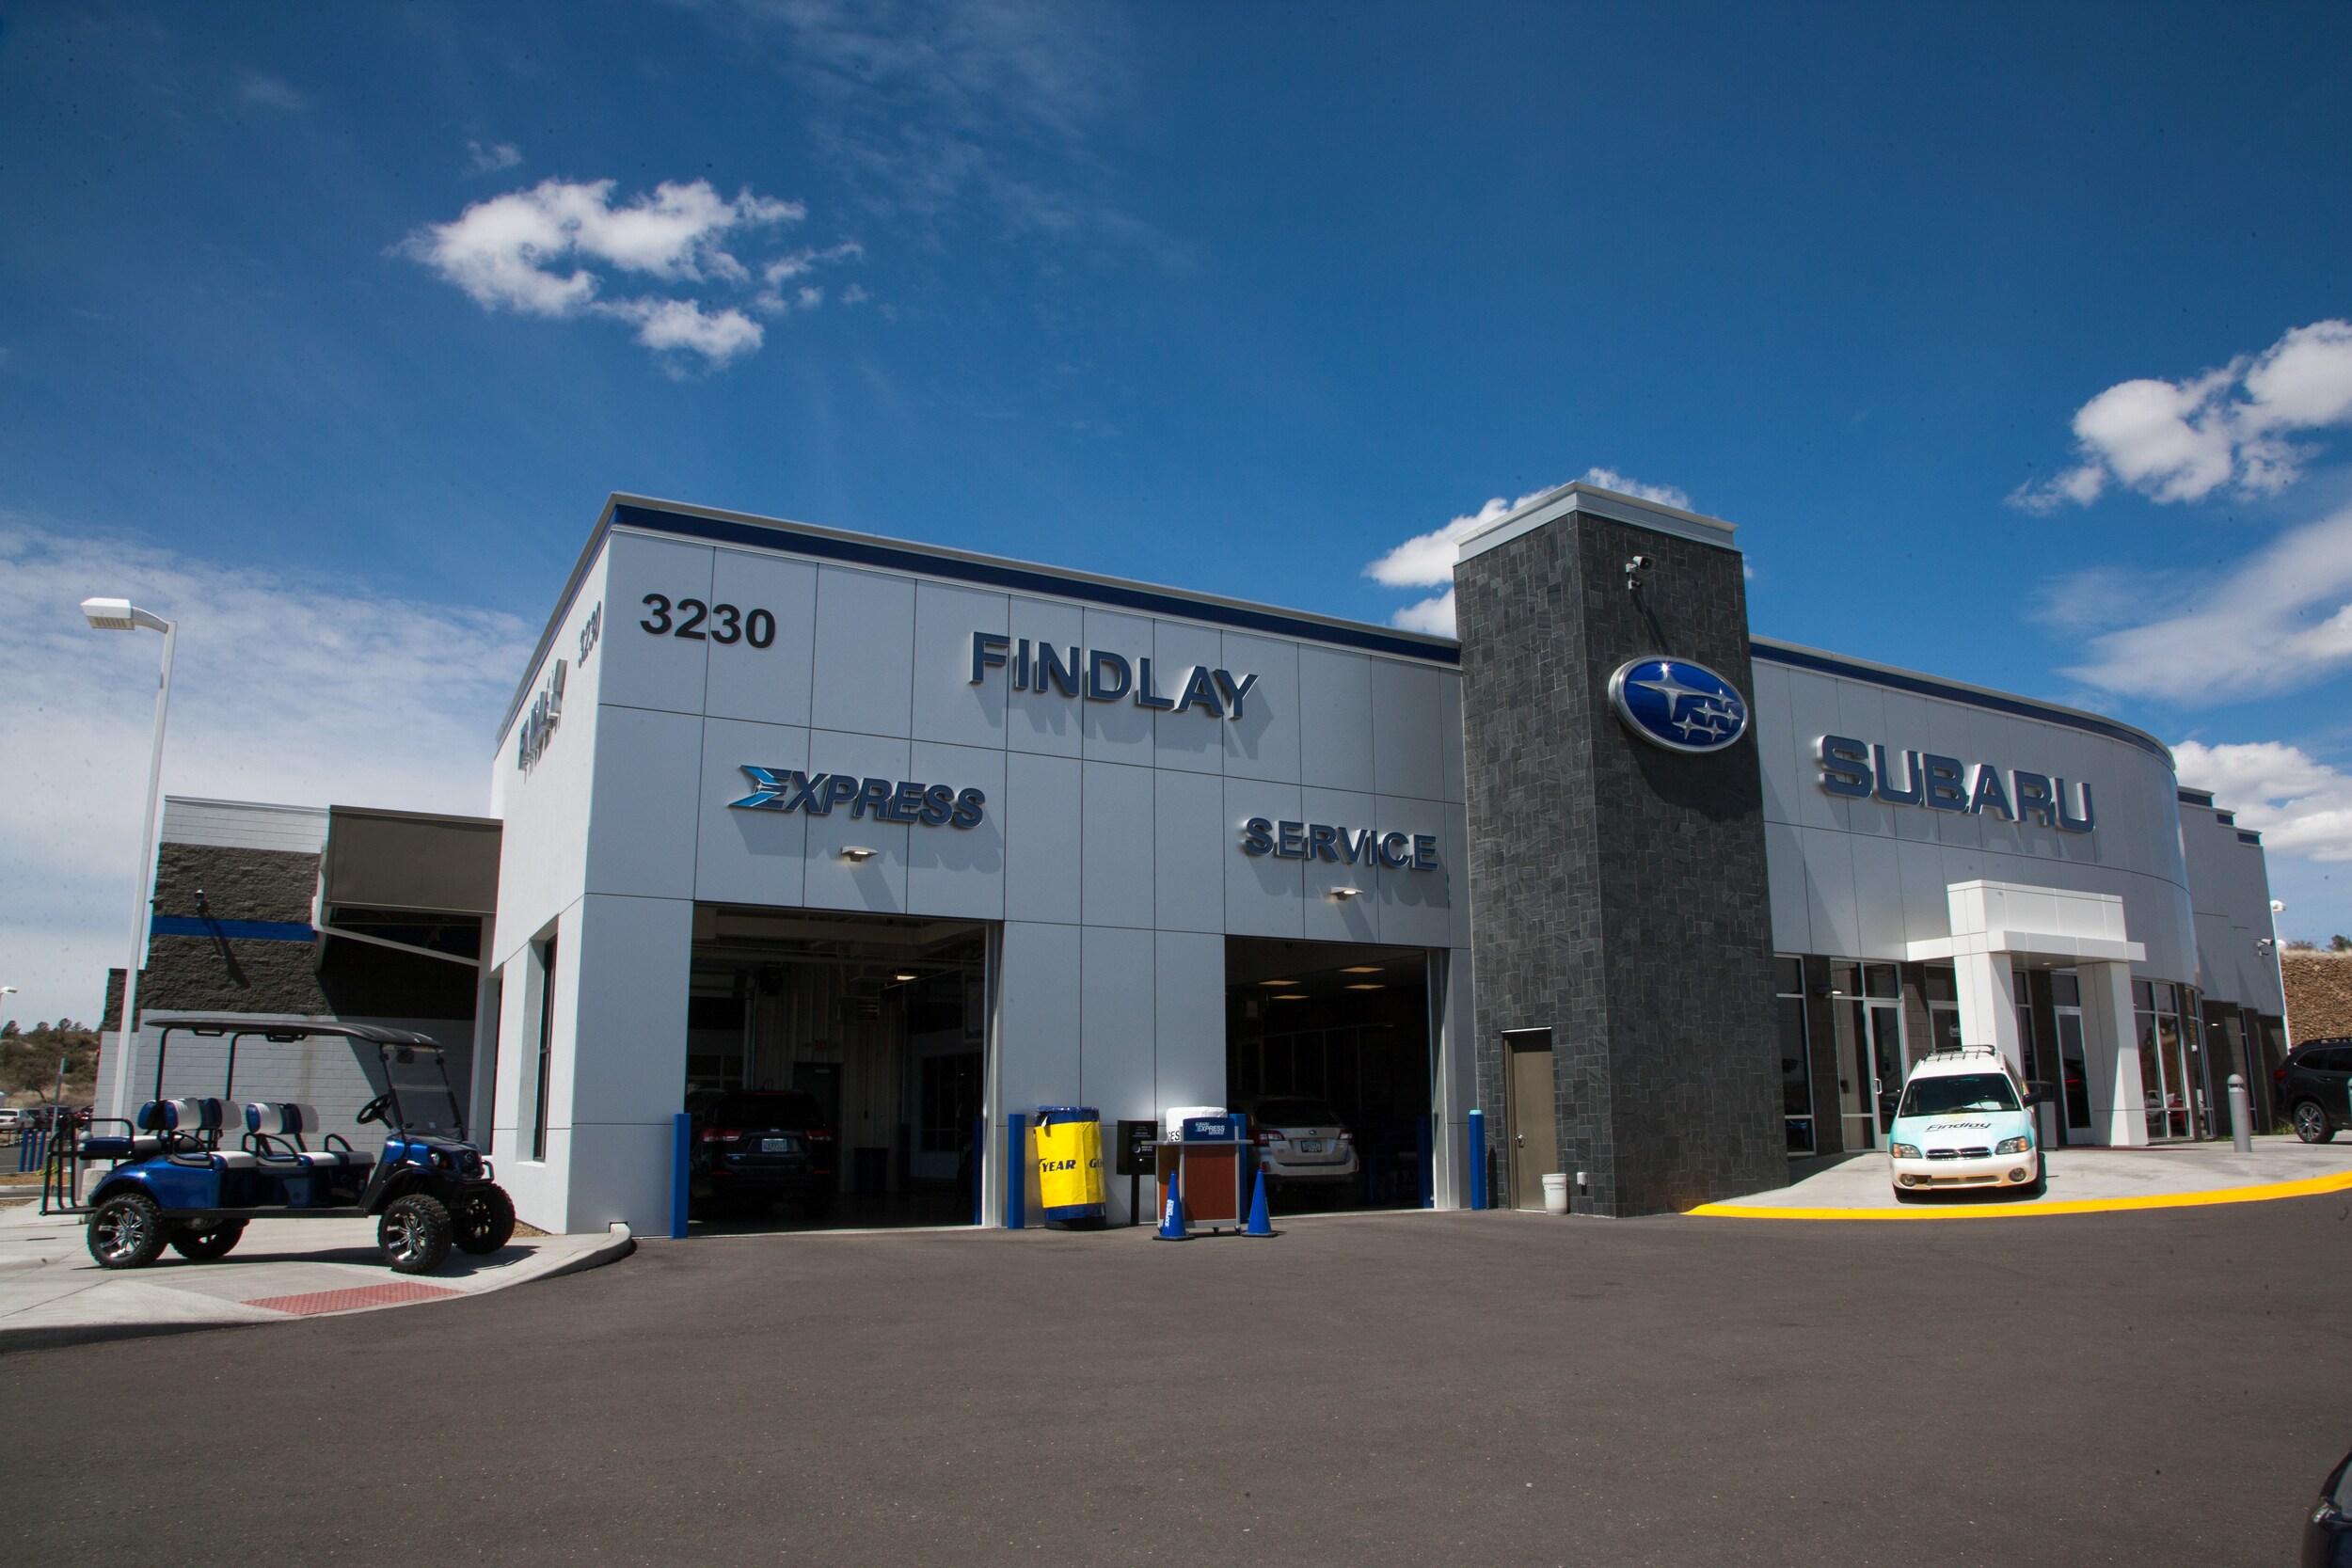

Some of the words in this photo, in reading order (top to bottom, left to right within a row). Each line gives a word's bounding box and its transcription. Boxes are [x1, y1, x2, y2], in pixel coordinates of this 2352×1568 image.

[579, 600, 602, 670] 3230
[641, 594, 775, 648] 3230
[970, 631, 1259, 720] FINDLAY
[728, 765, 986, 829] EXPRESS
[1817, 735, 2095, 833] SUBARU
[1242, 817, 1438, 870] SERVICE
[1925, 1121, 1992, 1132] Findlay
